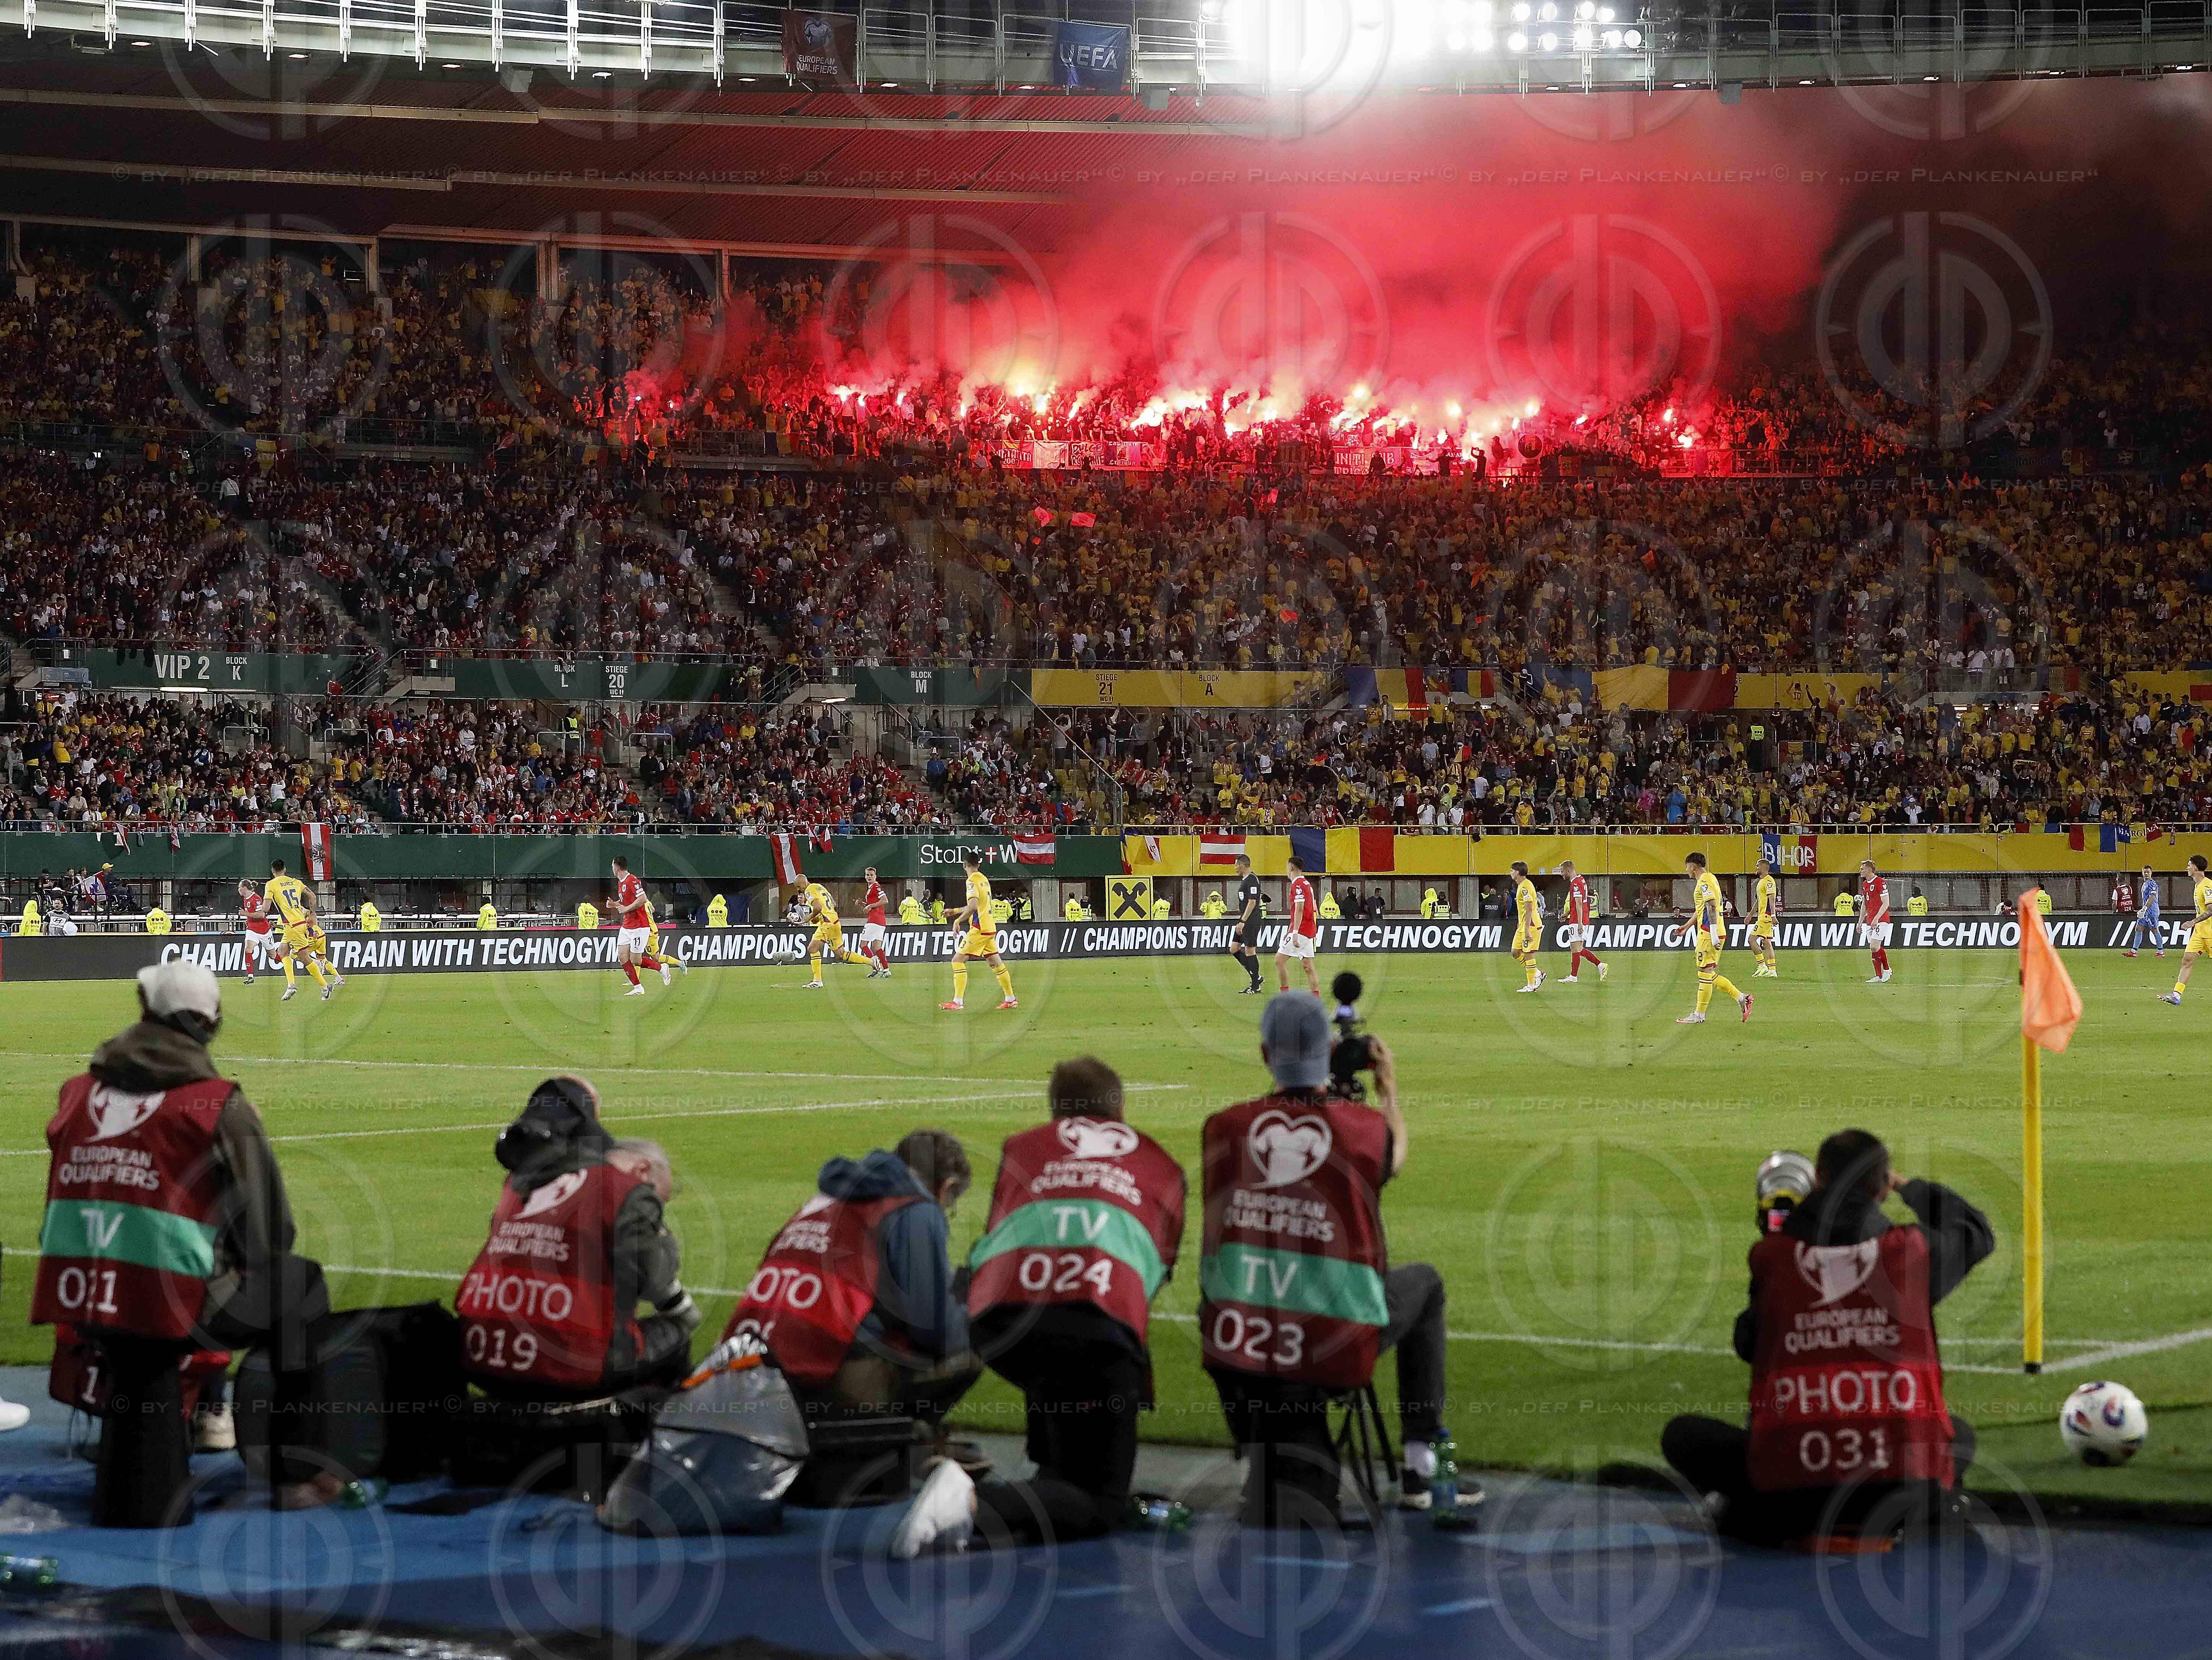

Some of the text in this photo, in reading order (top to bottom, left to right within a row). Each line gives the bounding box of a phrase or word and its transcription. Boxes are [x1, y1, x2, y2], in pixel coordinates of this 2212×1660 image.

[799, 55, 835, 65] EUROPEAN
[1060, 42, 1117, 69] UEFA
[796, 62, 838, 75] QUALIFIERS
[154, 654, 210, 680] VIP 2
[226, 656, 247, 665] BLOCK
[605, 665, 628, 674] STIEGE
[232, 666, 242, 680] K
[561, 674, 569, 687] L
[608, 674, 625, 688] 20
[910, 671, 932, 679] BLOCK
[916, 679, 927, 693] M
[1099, 682, 1113, 695] 21
[1205, 683, 1214, 696] A
[1764, 842, 1815, 867] BIHOR
[282, 889, 299, 909] 15
[1866, 892, 1870, 901] 6
[1083, 925, 1188, 951] CHAMPIONS
[1330, 925, 1503, 949] TECHNOGYM
[1555, 924, 1699, 948] CHAMPION
[1901, 921, 2089, 946] TECHNOYM
[1875, 924, 1880, 933] 6
[633, 937, 640, 946] 11
[677, 934, 807, 961] CHAMPIONS
[881, 932, 930, 957] WITH
[330, 939, 406, 968] TRAIN
[411, 938, 475, 967] WITH
[480, 936, 620, 965] TECHNOGYM
[1698, 952, 1703, 962] 2
[79, 1207, 124, 1249] TV
[1052, 1206, 1110, 1242] TV
[1018, 1253, 1114, 1296] 024
[1241, 1253, 1299, 1299] TV
[465, 1323, 538, 1371] 019
[1212, 1307, 1306, 1367] 023
[1773, 1369, 1918, 1414] PHOTO
[1798, 1426, 1890, 1473] 031
